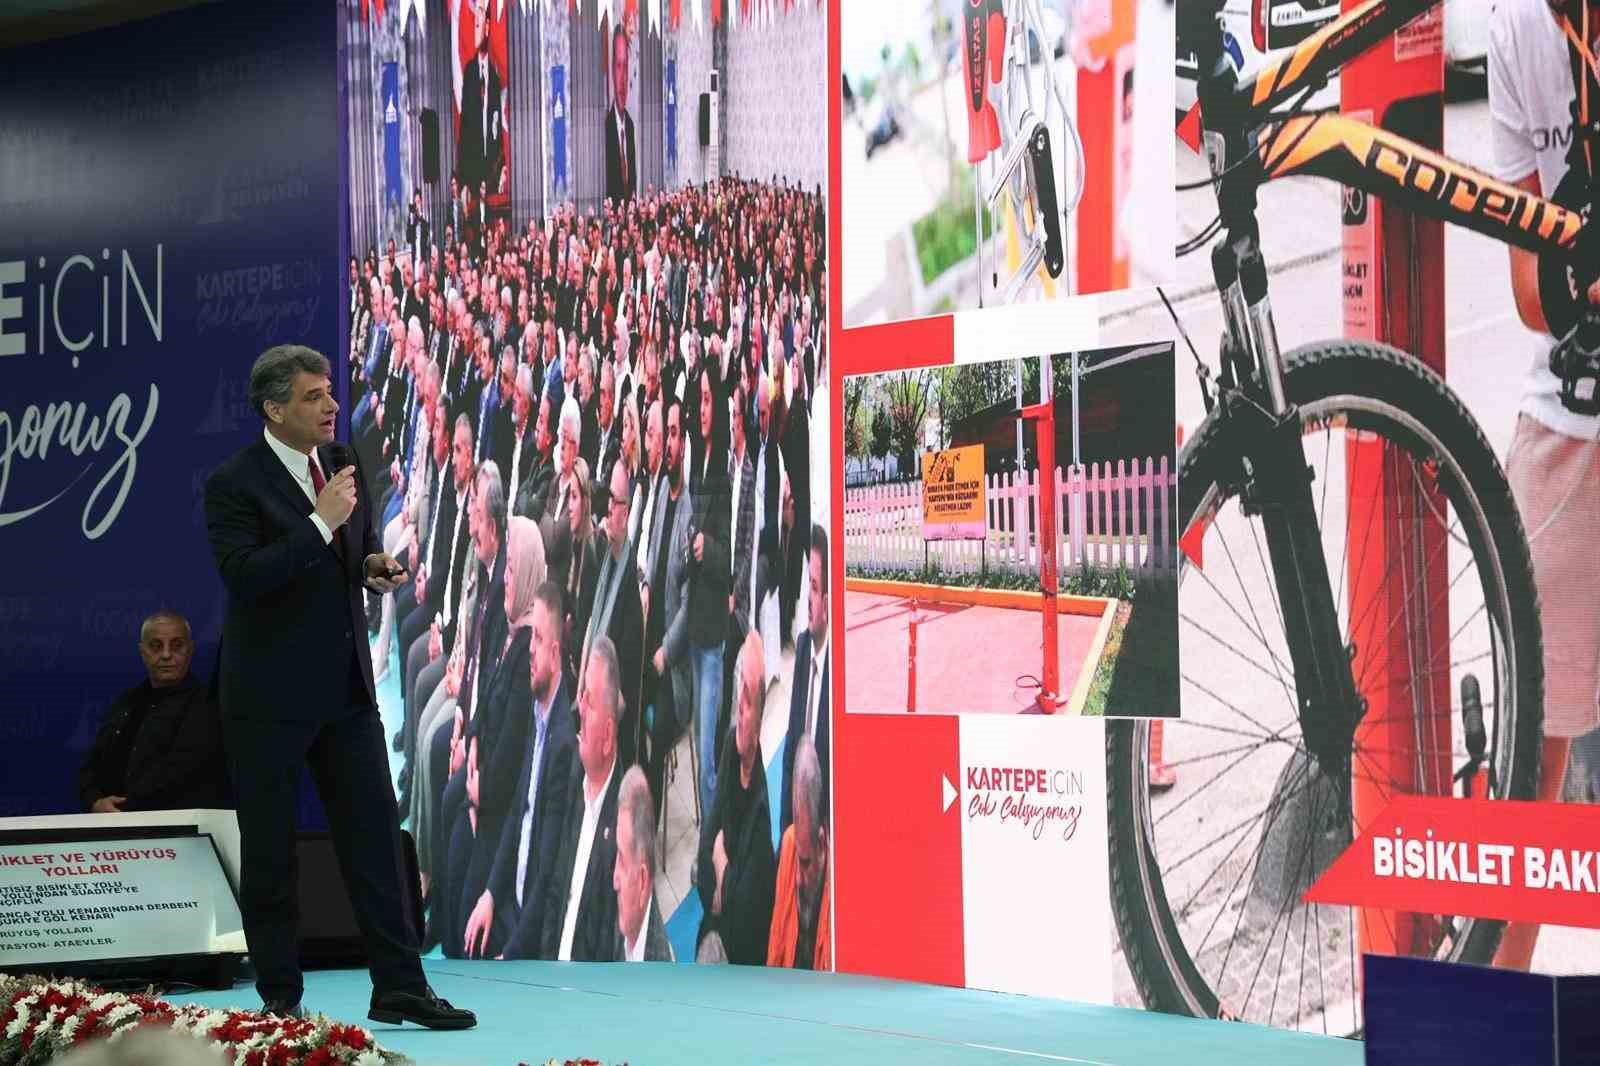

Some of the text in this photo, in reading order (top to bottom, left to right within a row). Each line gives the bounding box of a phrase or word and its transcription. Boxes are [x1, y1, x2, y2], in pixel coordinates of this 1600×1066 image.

[967, 766, 1047, 793] KARTEPE
[0, 848, 177, 866] İKLET VE YÜRÜYÜŞ
[1373, 826, 1514, 886] BİSİKLET
[41, 864, 119, 877] YOLLARI
[43, 926, 93, 936] YOLLARI
